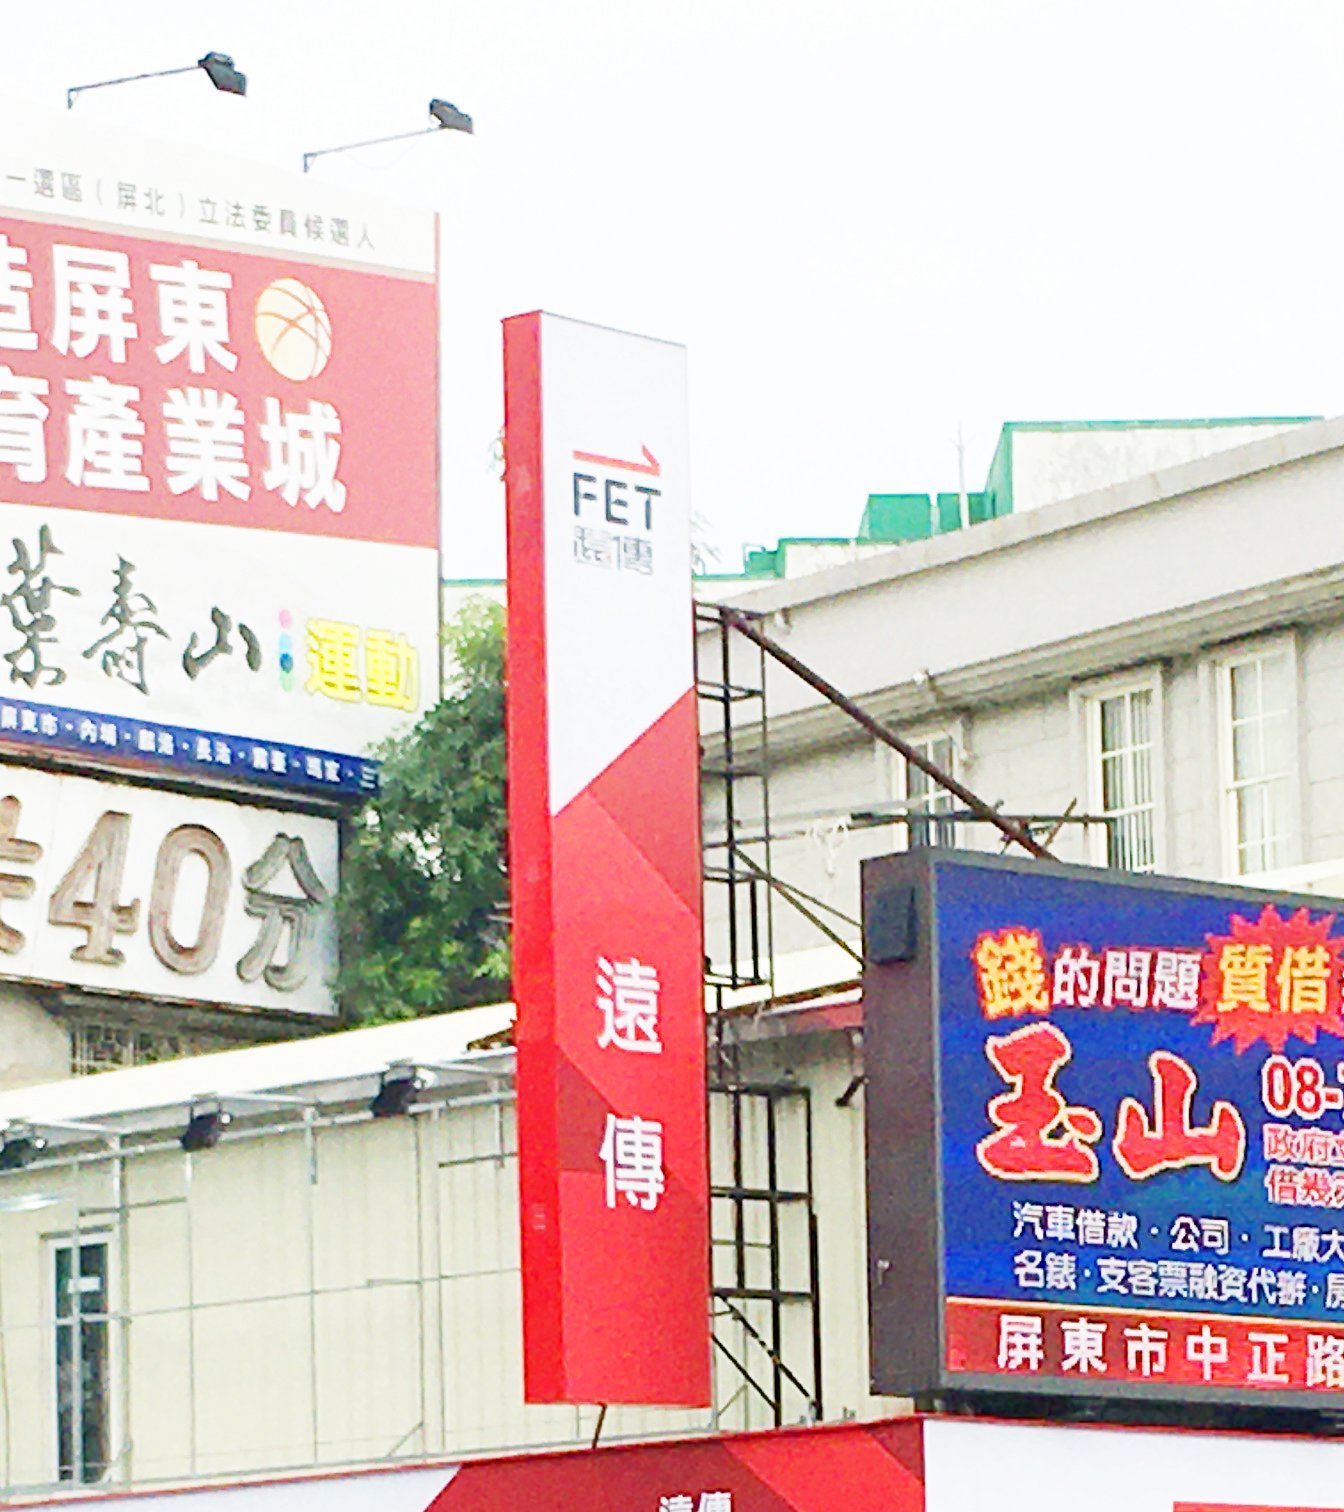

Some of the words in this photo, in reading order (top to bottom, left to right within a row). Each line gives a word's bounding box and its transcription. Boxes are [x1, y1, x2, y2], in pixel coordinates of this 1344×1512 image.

[572, 472, 661, 530] FET
[304, 617, 419, 713] 運動
[596, 955, 665, 1212] 遠傳
[974, 1021, 1247, 1183] 玉山
